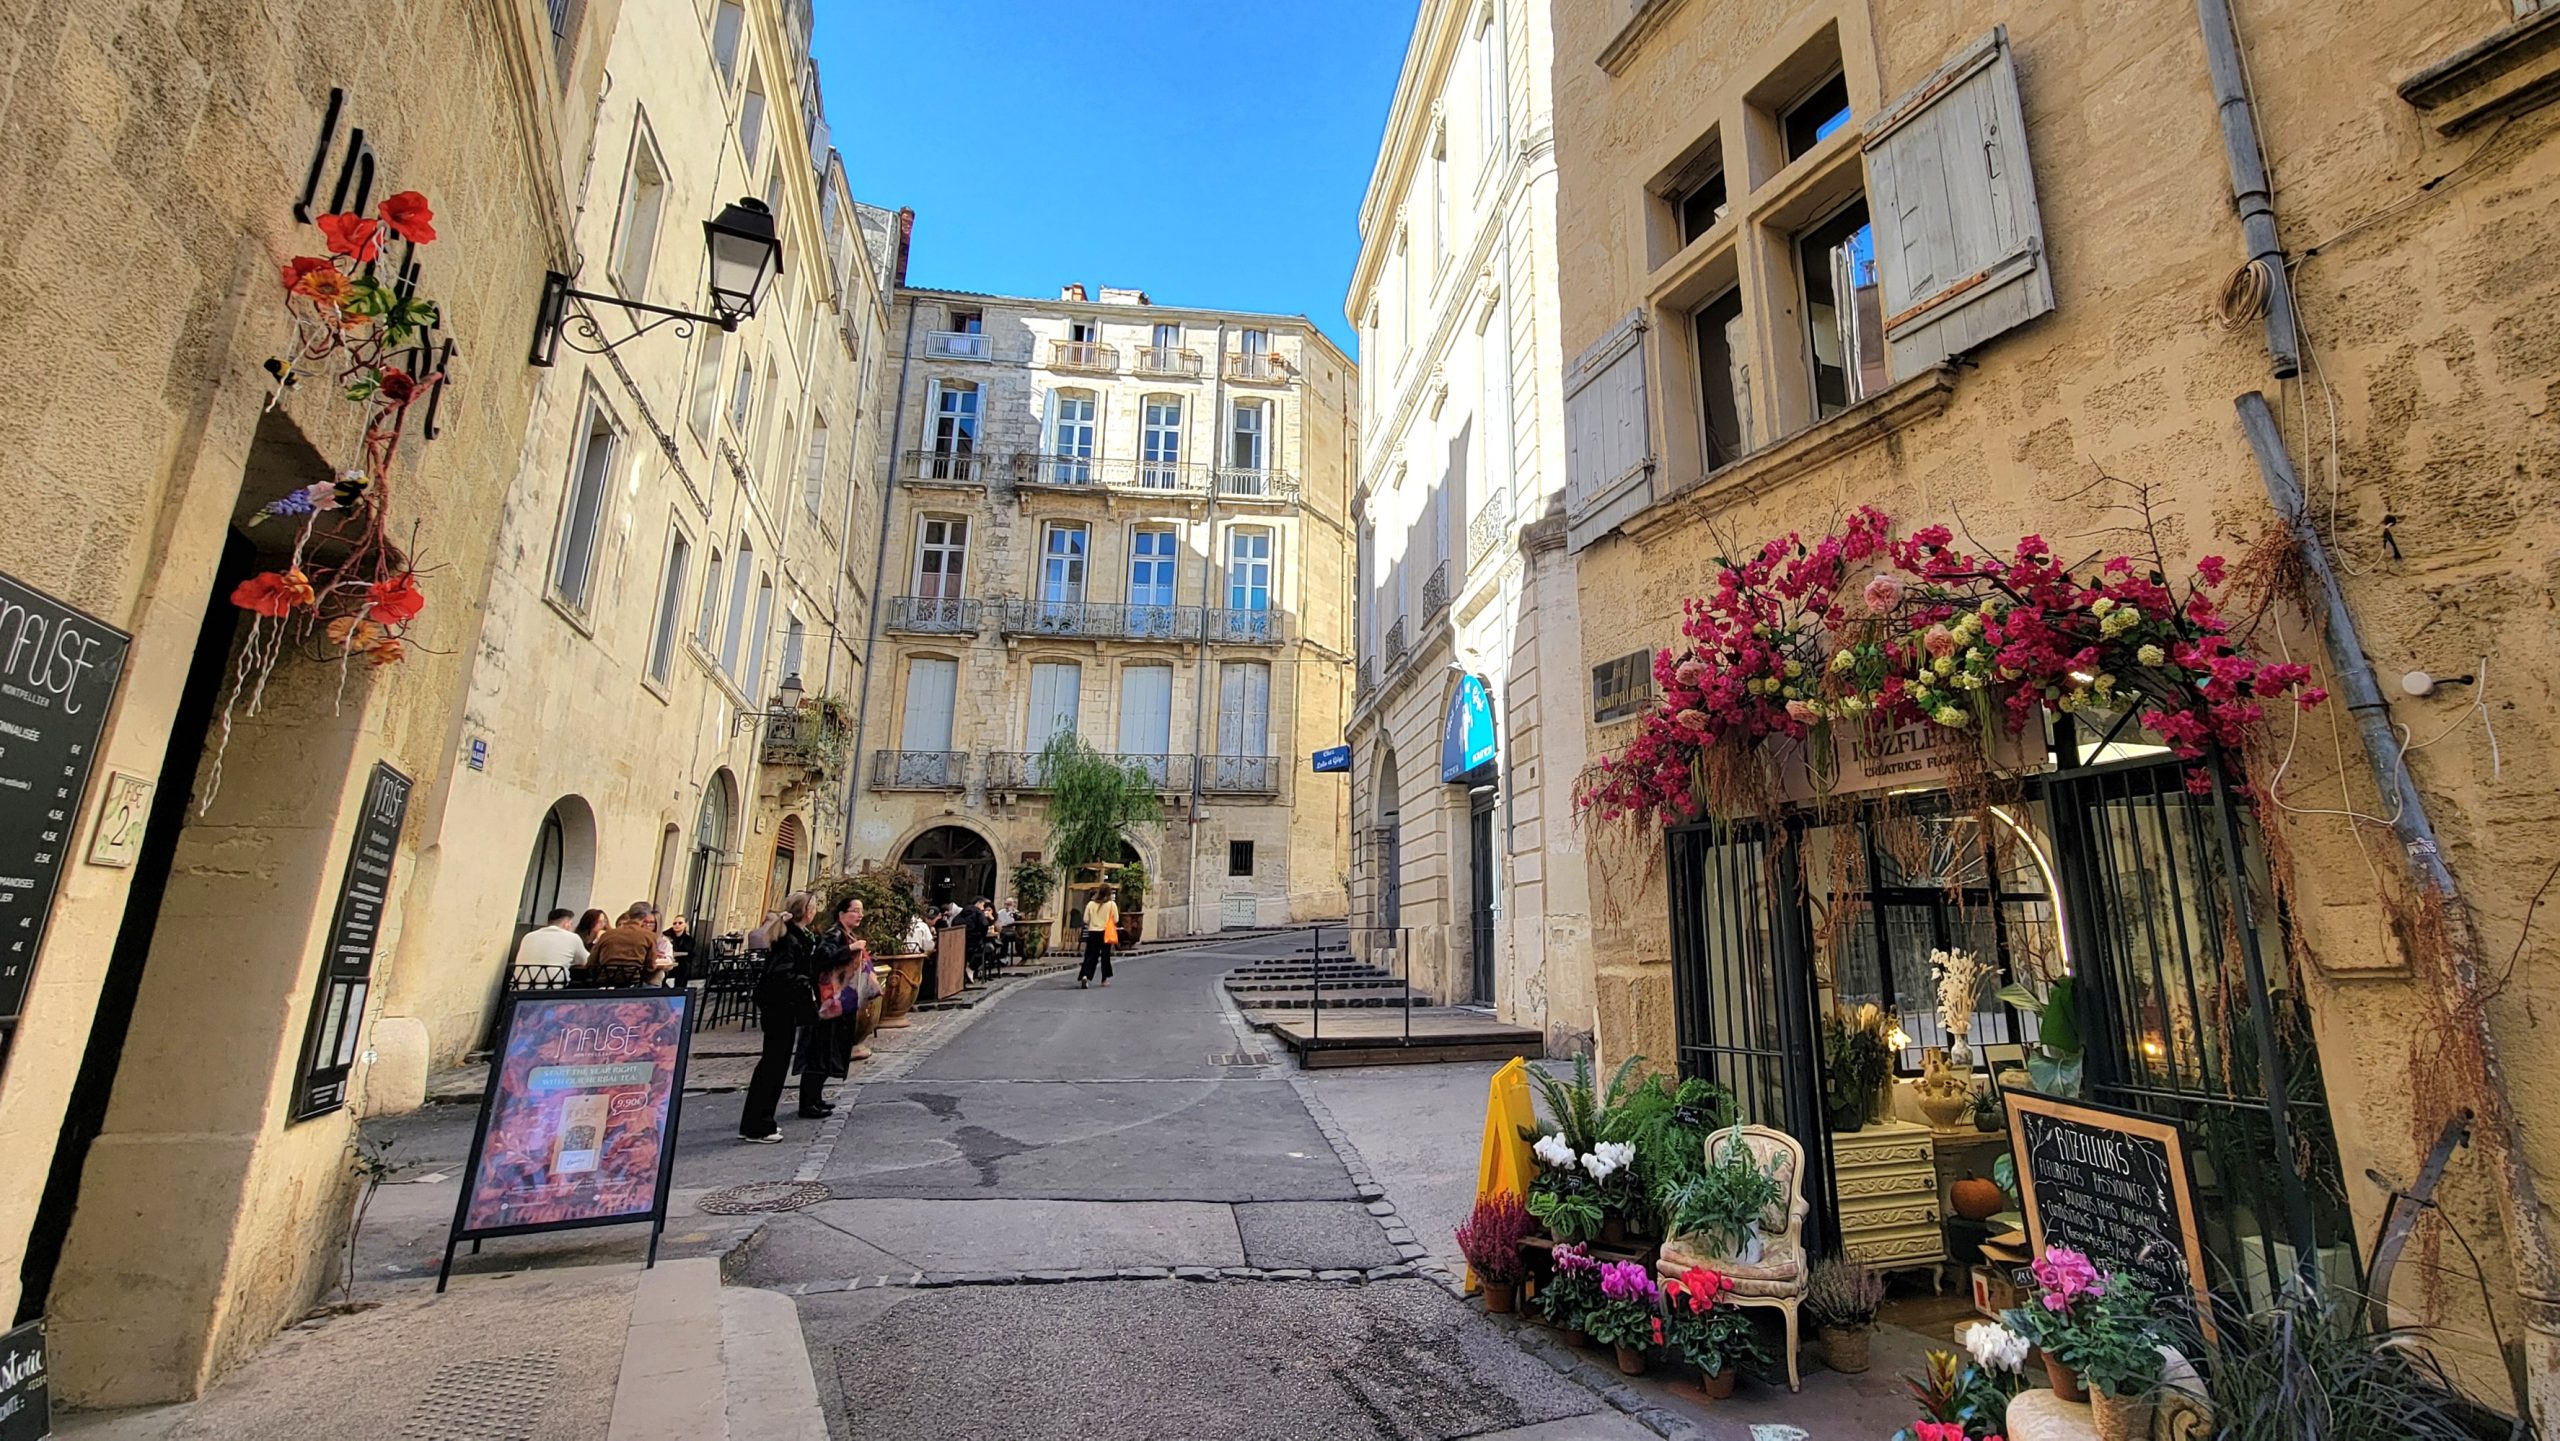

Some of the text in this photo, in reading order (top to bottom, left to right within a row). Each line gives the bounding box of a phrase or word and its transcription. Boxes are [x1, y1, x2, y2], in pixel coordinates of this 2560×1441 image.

[0, 597, 101, 714] NFUSE
[1613, 664, 1628, 679] RUE
[2, 683, 50, 708] MONTPELLIER
[110, 805, 129, 846] 2
[554, 1023, 641, 1059] INFUSE
[542, 1077, 564, 1086] WITH
[584, 1075, 618, 1084] HERBAL
[543, 1065, 638, 1077] START THE YEAR RIGHT
[2039, 1157, 2152, 1208] FLEURISTES PASSIONNÉES
